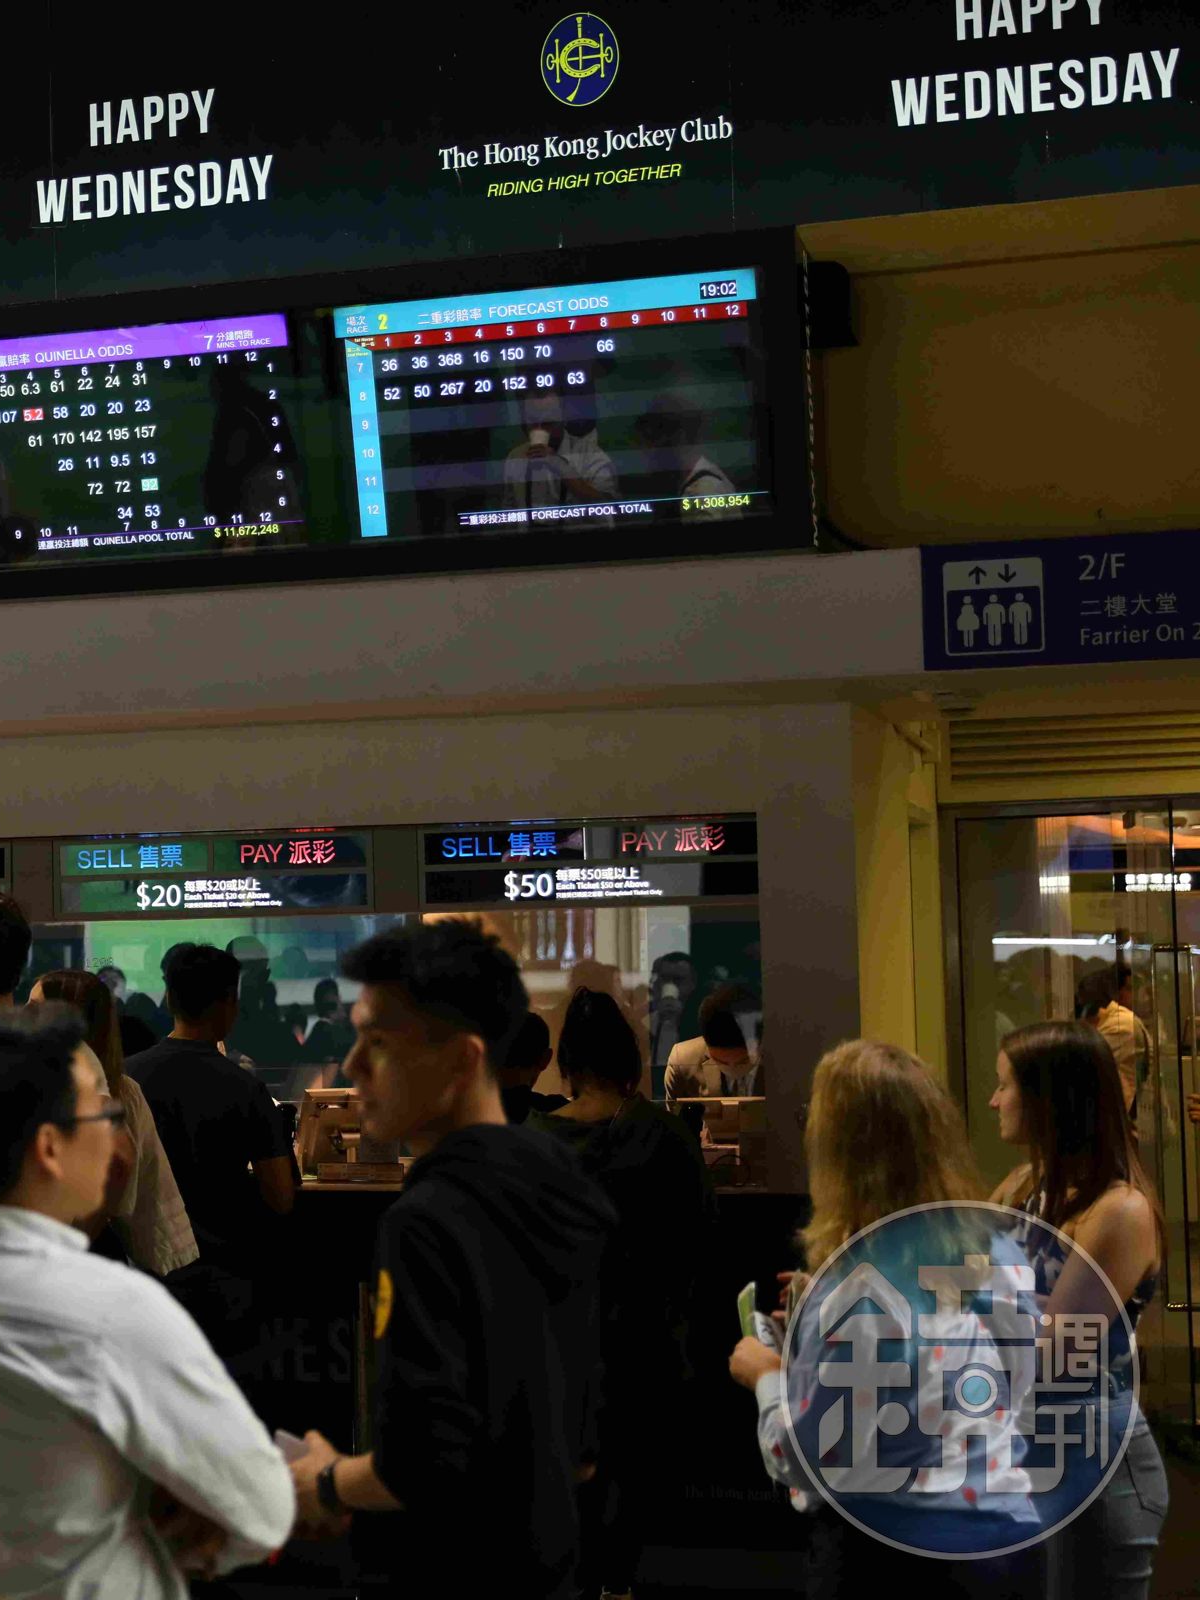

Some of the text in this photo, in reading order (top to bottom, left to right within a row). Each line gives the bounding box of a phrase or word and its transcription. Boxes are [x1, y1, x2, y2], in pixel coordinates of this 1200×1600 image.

[956, 0, 1101, 40] HAPPY
[891, 48, 1179, 127] WEDNESDAY
[90, 88, 215, 147] HAPPY
[439, 115, 733, 170] The Hong Kong Jockey Club
[36, 155, 273, 223] WEDNESDAY
[487, 164, 682, 197] RIDING HIGH TOGETHER
[701, 281, 736, 297] 19:02
[417, 296, 608, 326] 二重彩賠率 FORECAST ODDS
[35, 347, 95, 363] QUINELLA
[98, 344, 133, 357] ODDS
[381, 339, 613, 371] 36 36 368 16 150 70 66
[24, 408, 43, 421] 5.2
[53, 406, 68, 419] 58
[80, 404, 95, 417] 20
[107, 402, 123, 415] 20
[134, 400, 150, 412] 23
[532, 506, 586, 519] FORECAST
[588, 505, 617, 516] POOL
[619, 503, 652, 514] TOTAL
[694, 494, 749, 509] 1,308,954
[93, 535, 136, 546] QUINELLA
[139, 534, 162, 543] POOL
[164, 532, 194, 542] TOTAL
[224, 524, 279, 537] 11,672,248
[1078, 553, 1125, 580] 2/F
[1080, 592, 1178, 618] 二樓大堂
[1080, 626, 1150, 646] Farrier
[1156, 624, 1184, 642] On
[442, 832, 557, 857] SELL 售票
[621, 826, 725, 851] PAY 派彩
[77, 844, 182, 869] SELL 售票
[240, 840, 336, 864] PAY 派彩
[136, 882, 180, 910] $20
[504, 871, 552, 900] $50
[576, 881, 599, 889] Ticket
[600, 881, 613, 889] $50
[624, 880, 648, 888] Above
